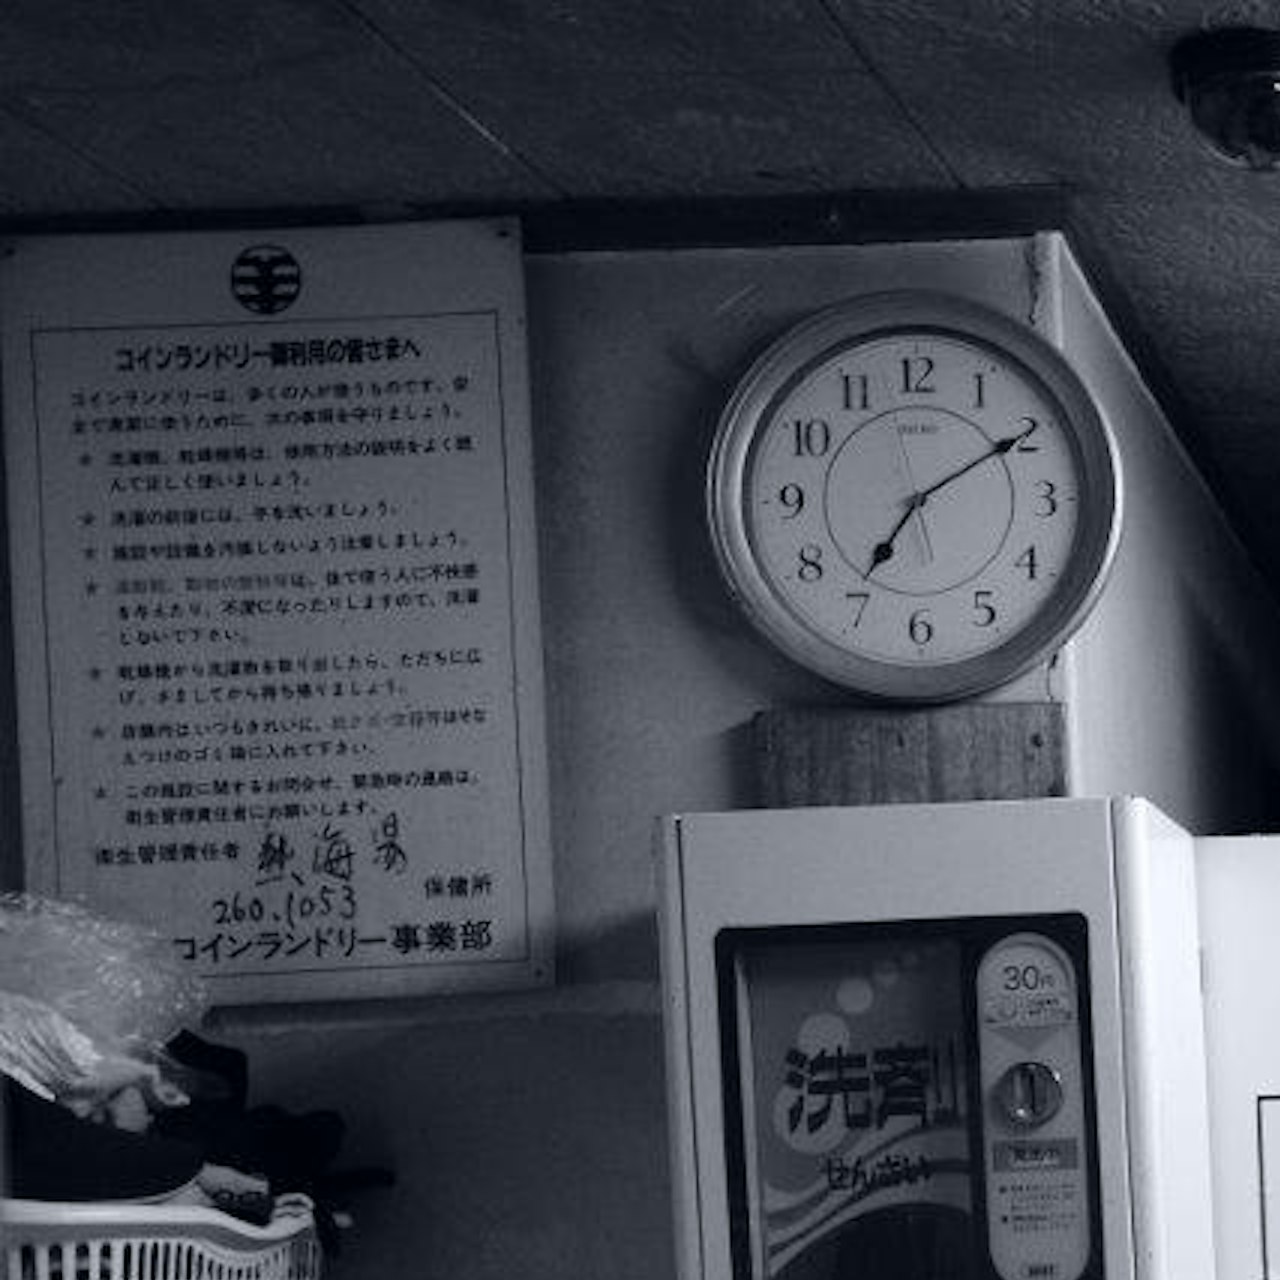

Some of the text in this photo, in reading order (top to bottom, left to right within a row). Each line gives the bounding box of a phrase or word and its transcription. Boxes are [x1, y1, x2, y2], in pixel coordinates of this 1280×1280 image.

[841, 373, 869, 410] 11
[900, 356, 935, 393] 12
[973, 372, 985, 408] 1
[792, 419, 830, 456] 10
[1015, 416, 1039, 453] 2
[779, 482, 805, 519] 9
[1034, 480, 1057, 517] 3
[797, 543, 824, 582] 8
[1013, 545, 1037, 581] 4
[845, 592, 871, 628] 7
[908, 609, 934, 645] 6
[973, 590, 997, 627] 5
[95, 842, 240, 867] 衛生管理責任者
[173, 920, 493, 963] コインランドリー事業部
